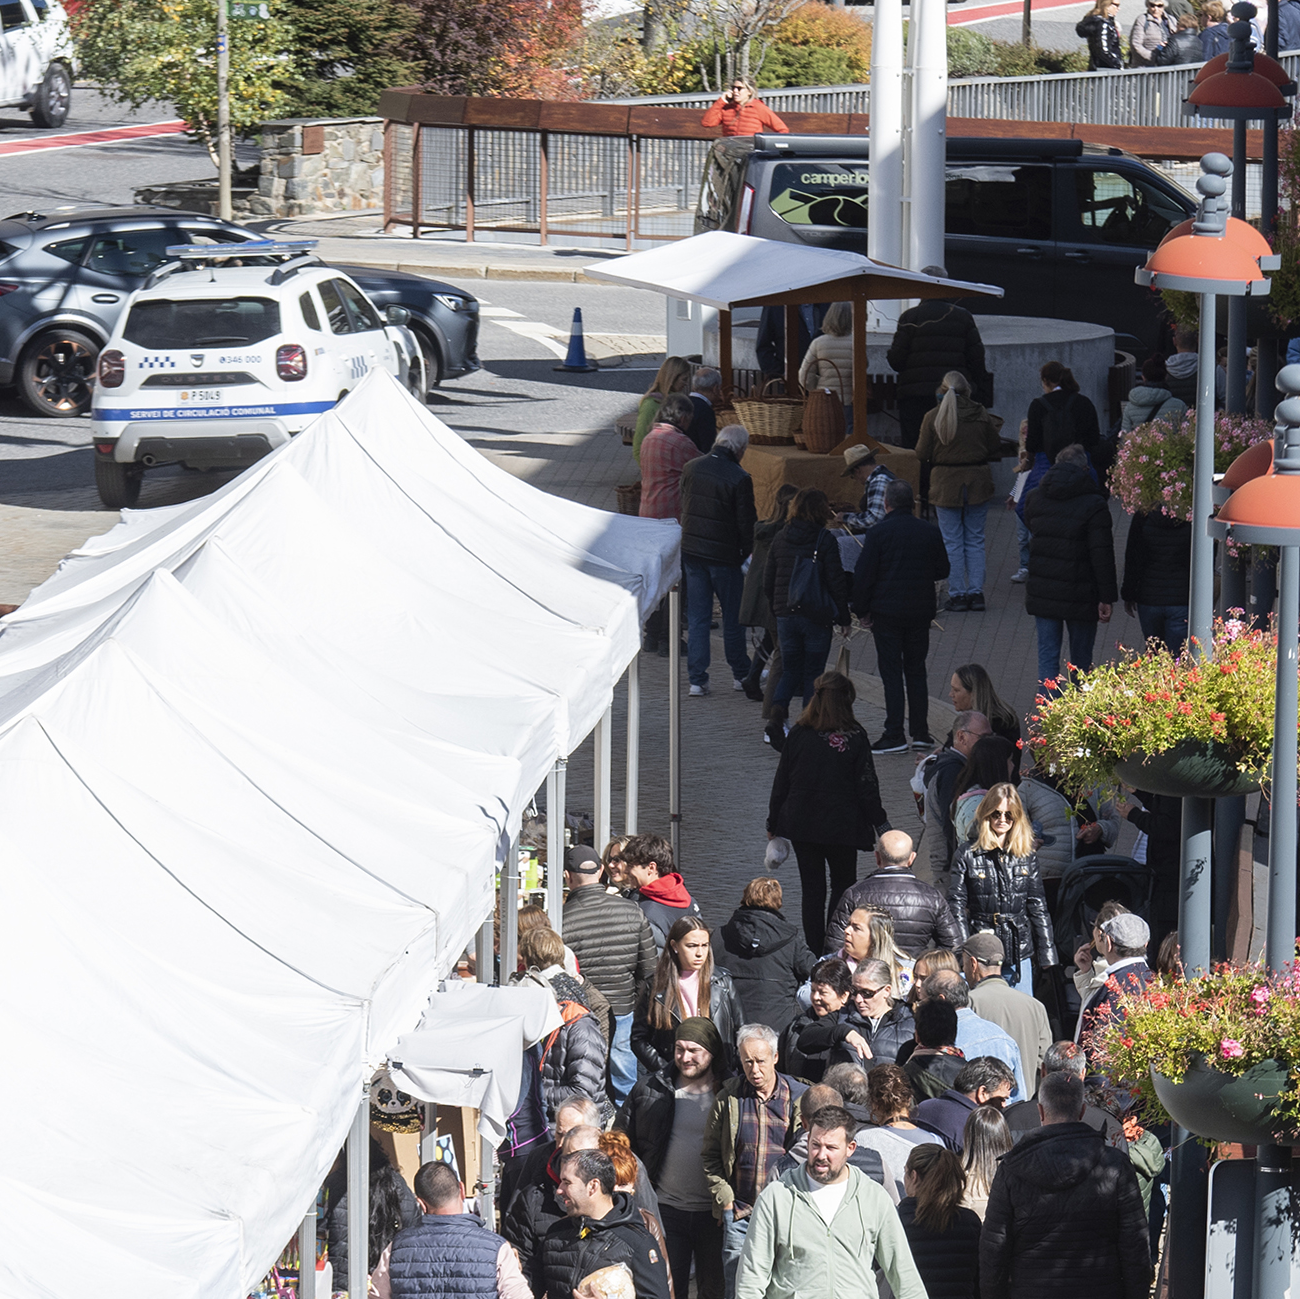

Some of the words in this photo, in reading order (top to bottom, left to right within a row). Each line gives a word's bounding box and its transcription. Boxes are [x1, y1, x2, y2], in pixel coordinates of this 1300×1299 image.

[130, 410, 161, 418] SERVEI
[162, 410, 175, 418] DE
[176, 408, 230, 418] CIRCULACIÓ
[231, 407, 276, 416] COMUNAL
